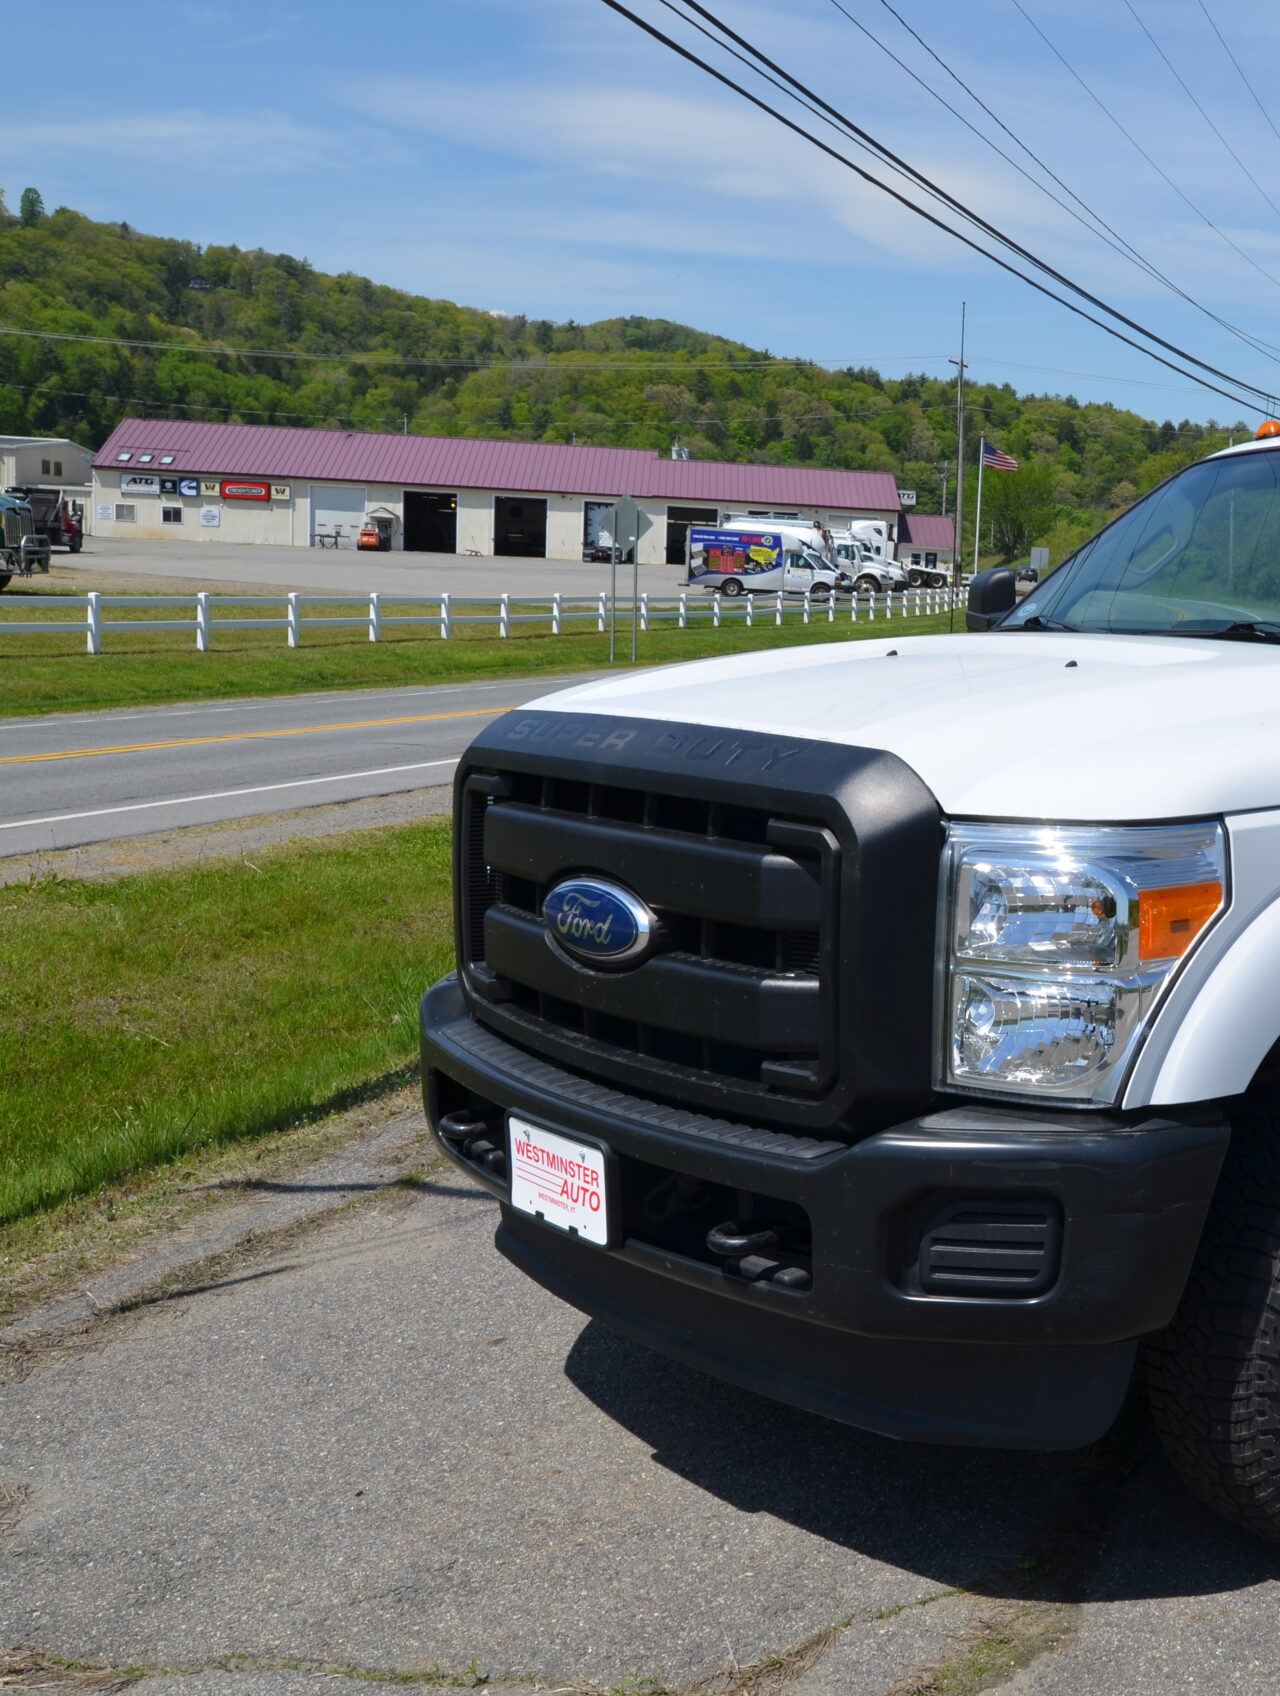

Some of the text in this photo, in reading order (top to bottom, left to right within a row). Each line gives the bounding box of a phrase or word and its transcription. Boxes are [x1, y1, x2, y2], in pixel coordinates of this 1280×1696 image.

[127, 476, 154, 486] ATG
[507, 719, 800, 771] SUPER DUTY
[557, 892, 614, 945] Ford
[515, 1138, 599, 1188] WESTMINSTER
[560, 1179, 601, 1212] AUTO
